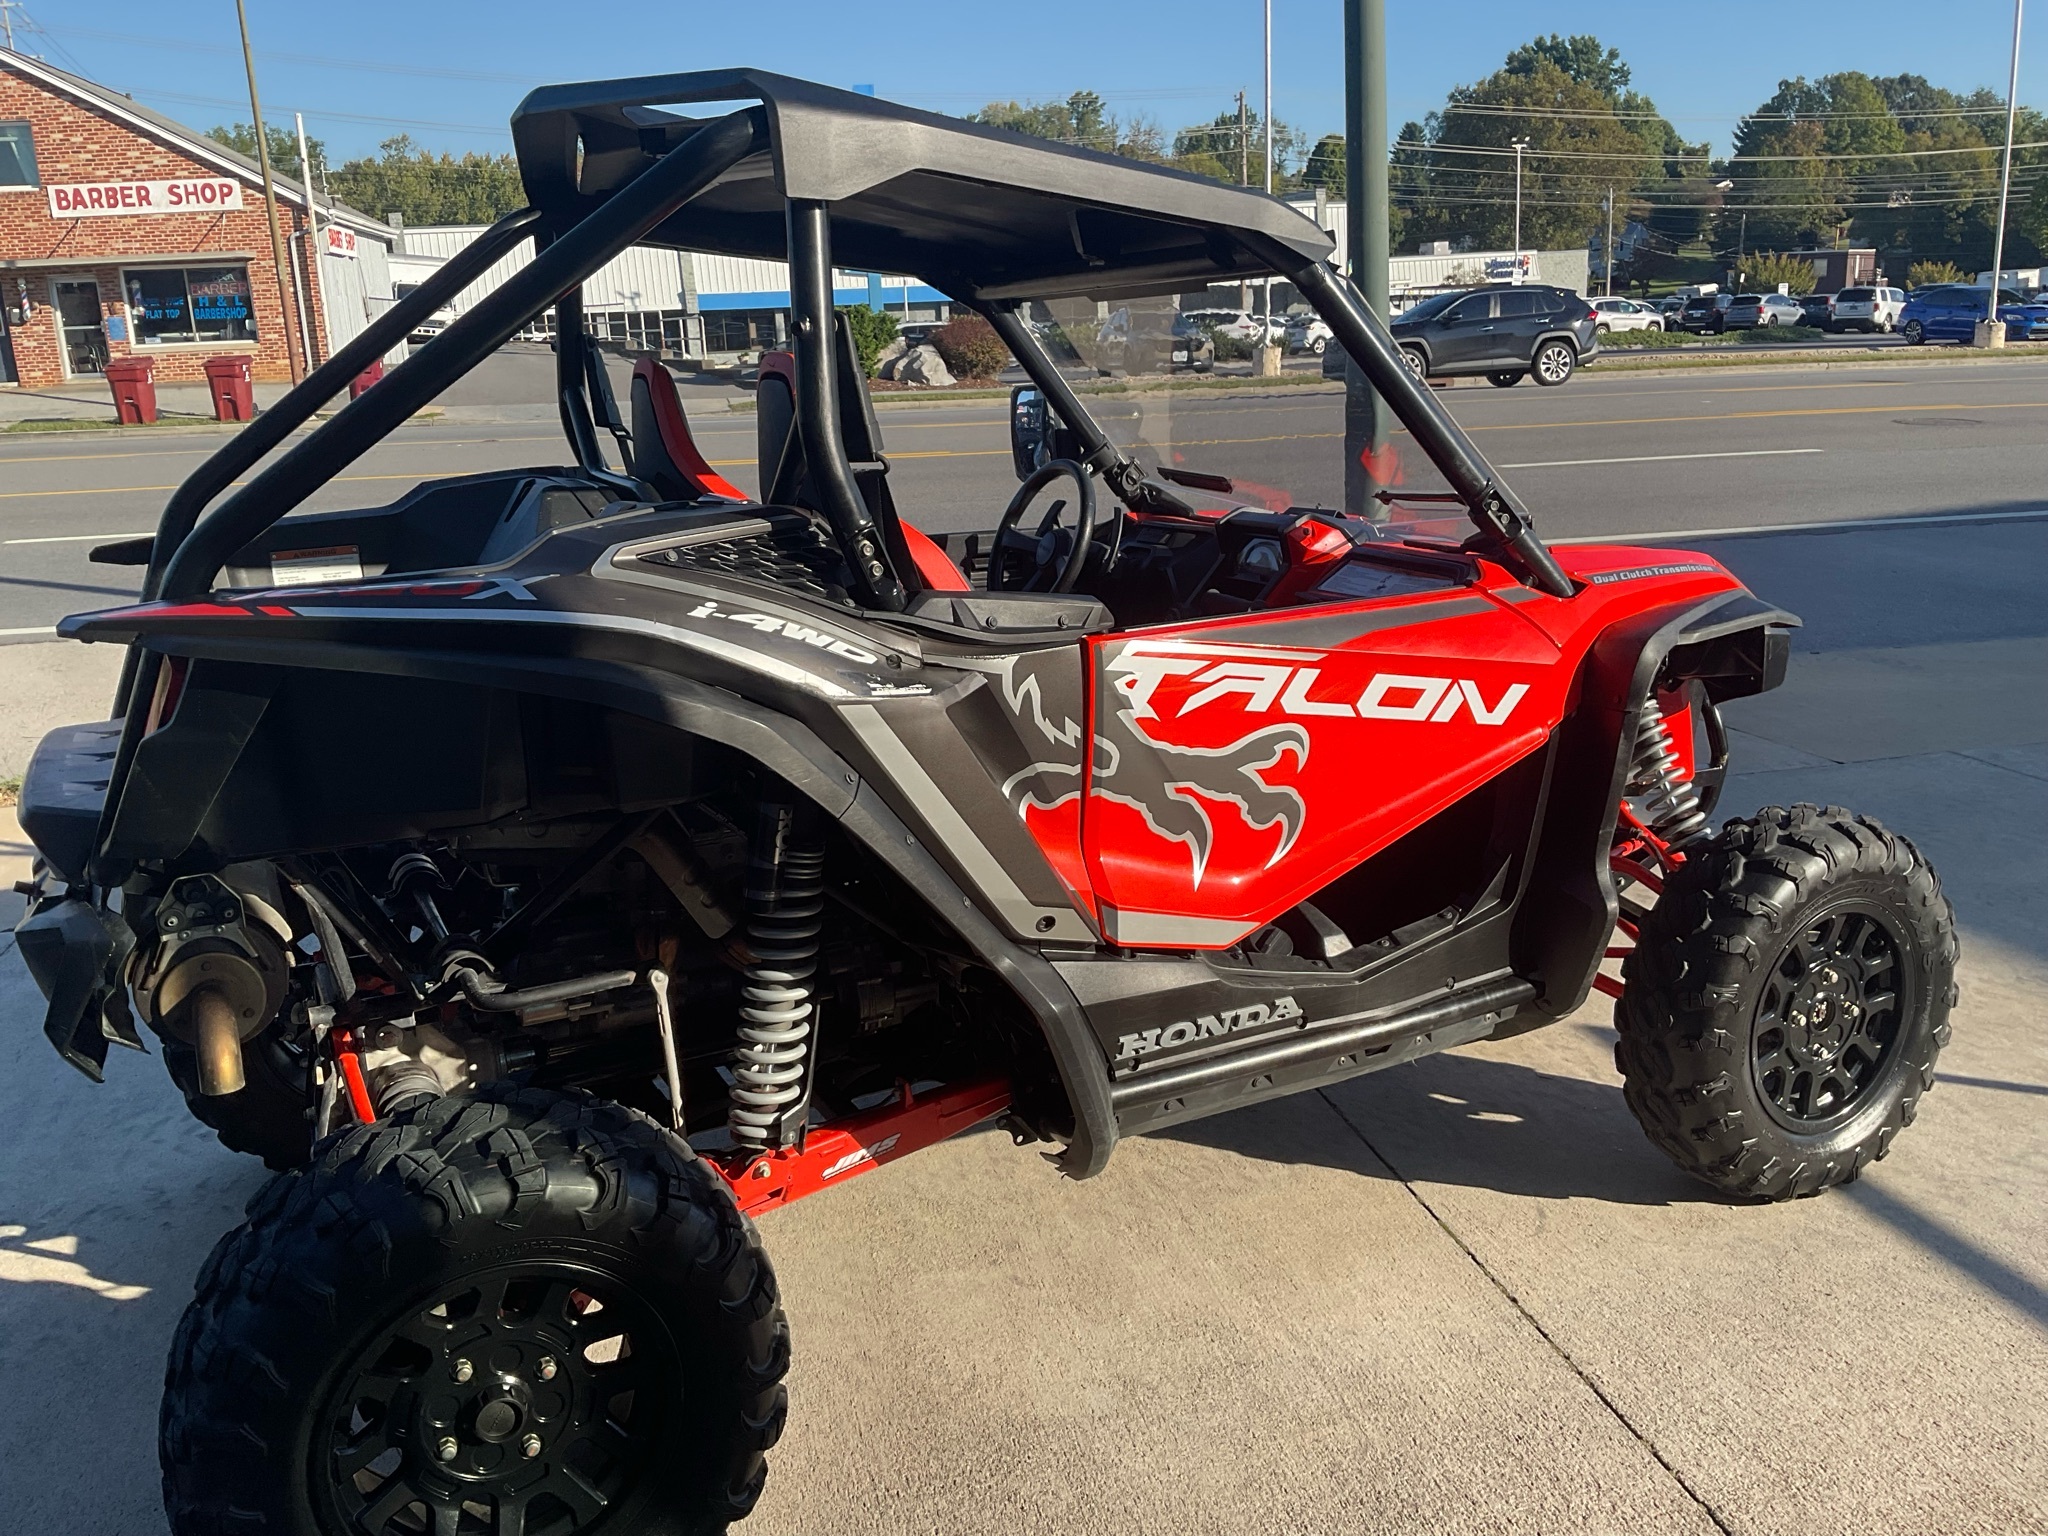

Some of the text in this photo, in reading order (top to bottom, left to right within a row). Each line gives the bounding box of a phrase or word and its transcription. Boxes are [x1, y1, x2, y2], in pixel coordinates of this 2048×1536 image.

[54, 182, 234, 211] BARBER SHOP
[190, 282, 248, 296] BARBER
[198, 294, 243, 307] H & L
[145, 309, 180, 319] FLAT TOP
[194, 307, 248, 320] BARBERSHOP
[1593, 564, 1713, 584] Dual Clutch Transmission
[687, 601, 878, 665] i-4WD
[1105, 642, 1530, 726] TALON
[1114, 995, 1304, 1061] HONDA
